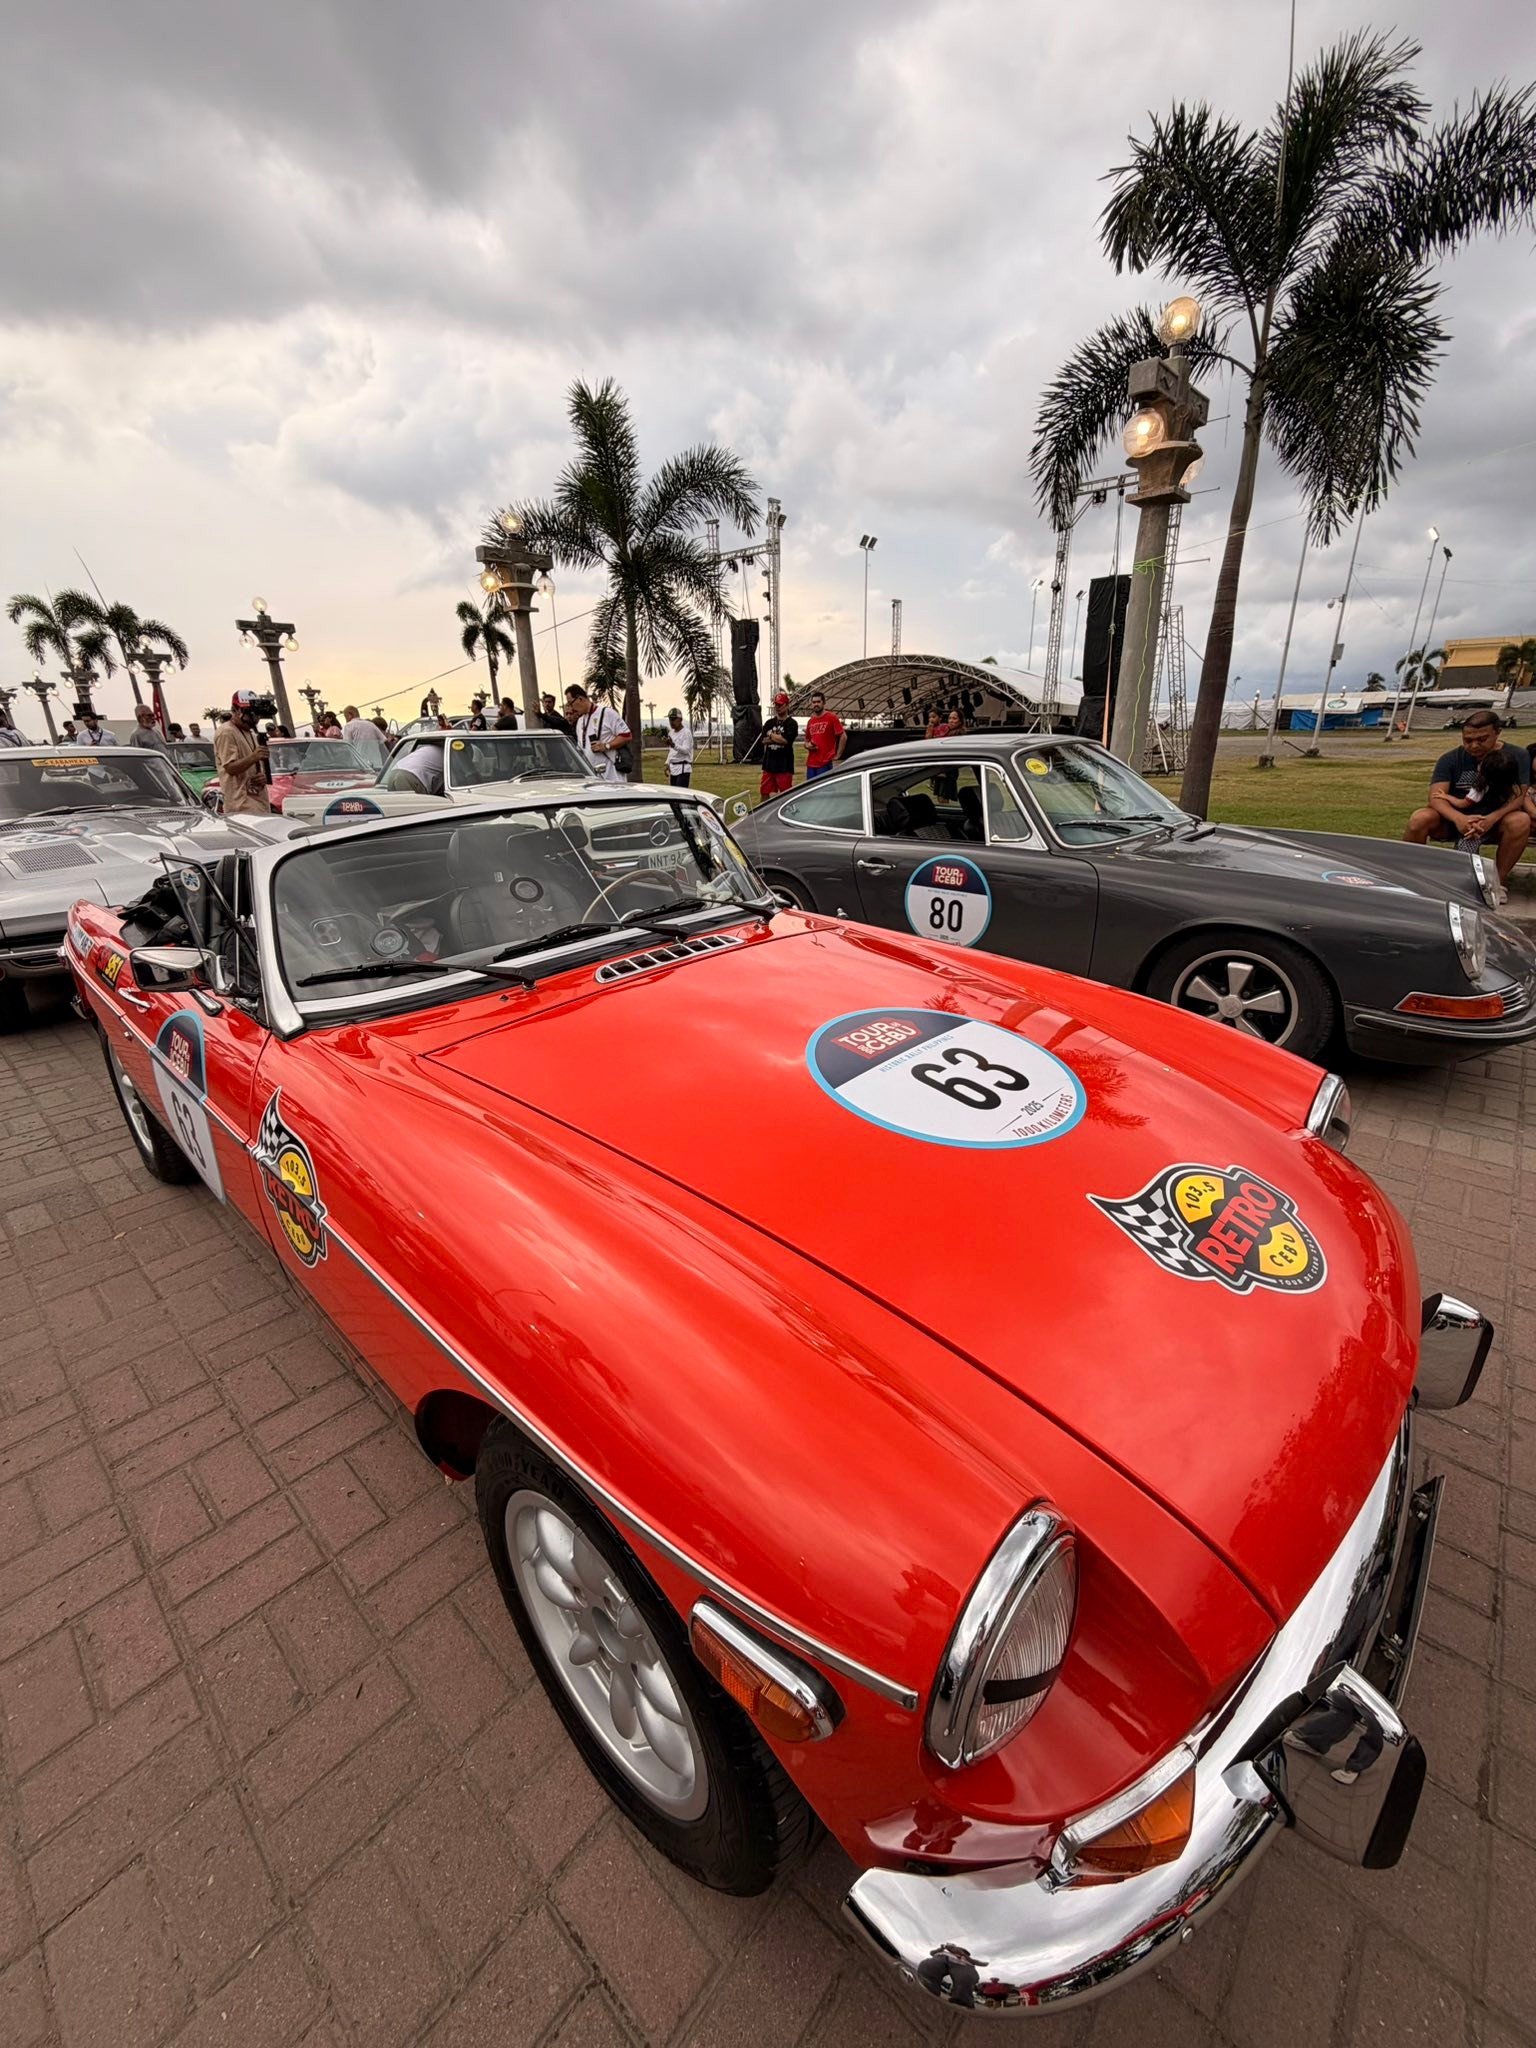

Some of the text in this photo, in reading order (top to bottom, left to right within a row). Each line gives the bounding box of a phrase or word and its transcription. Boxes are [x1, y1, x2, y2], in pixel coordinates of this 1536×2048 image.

[935, 866, 960, 877] TOUR
[938, 875, 963, 886] CEBU
[929, 896, 963, 932] 80
[104, 953, 124, 982] 951
[172, 1031, 189, 1056] TOUR
[838, 1022, 894, 1046] TOUR
[865, 1025, 917, 1051] CEBU
[879, 1056, 908, 1073] HISTORIC
[922, 1033, 955, 1051] PHILIPPINES
[911, 1047, 1030, 1110] 63
[1012, 1093, 1074, 1139] 1000 KILOMETERS
[1020, 1100, 1044, 1117] 2025
[171, 1091, 207, 1169] 63
[1185, 1181, 1216, 1210] 103.5
[1195, 1182, 1277, 1275] RETRO
[1269, 1232, 1298, 1267] CEBU
[1278, 1278, 1303, 1286] TOUR
[1303, 1273, 1314, 1282] DE
